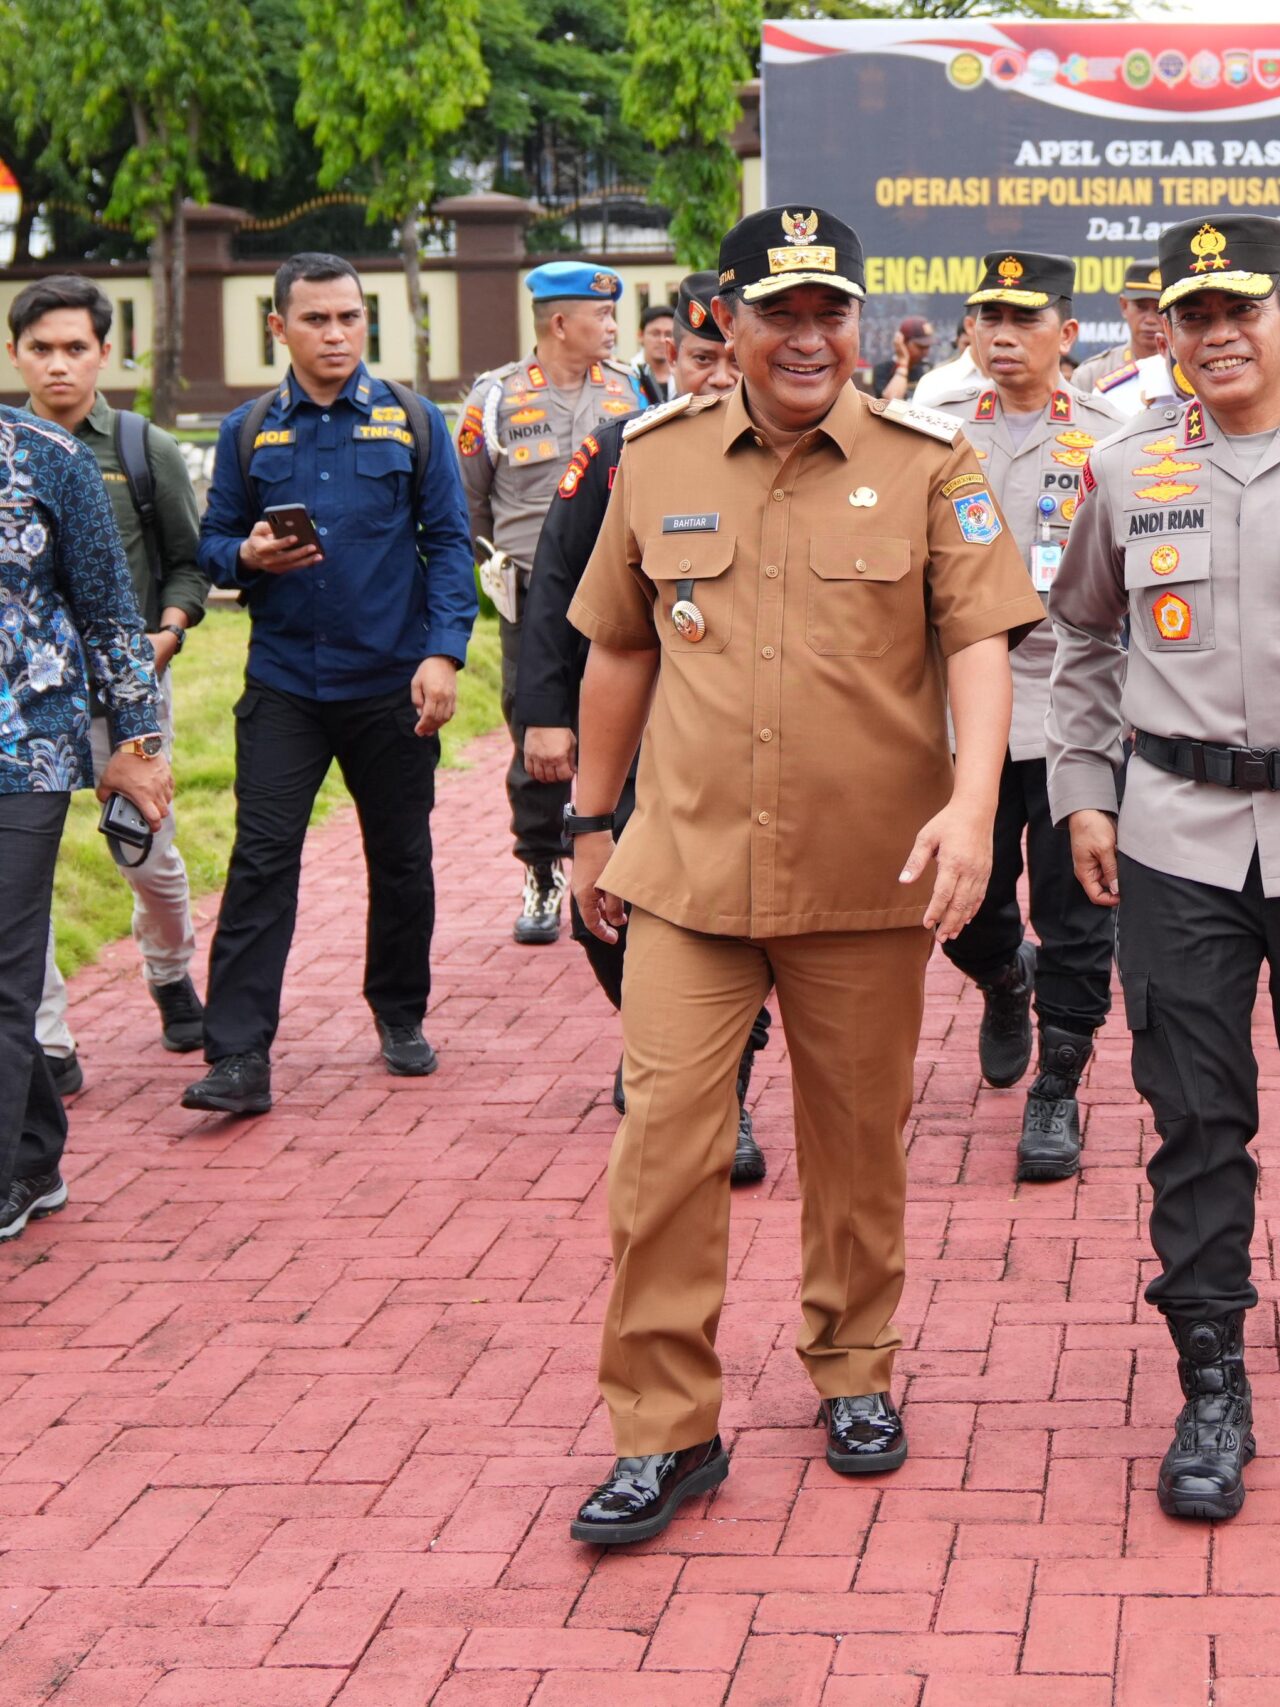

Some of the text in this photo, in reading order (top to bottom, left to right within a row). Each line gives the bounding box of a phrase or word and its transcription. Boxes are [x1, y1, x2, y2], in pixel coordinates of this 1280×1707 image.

[1014, 139, 1101, 167] APEL
[1104, 139, 1218, 167] GELAR
[875, 176, 990, 207] OPERASI
[997, 177, 1154, 206] KEPOLISIAN
[1086, 216, 1176, 241] Dala
[1071, 256, 1135, 294] IDU
[359, 425, 414, 445] TNI-AD
[508, 423, 553, 441] INDRA
[673, 517, 707, 529] BAHTIAR
[1129, 508, 1205, 536] ANDI RIAN
